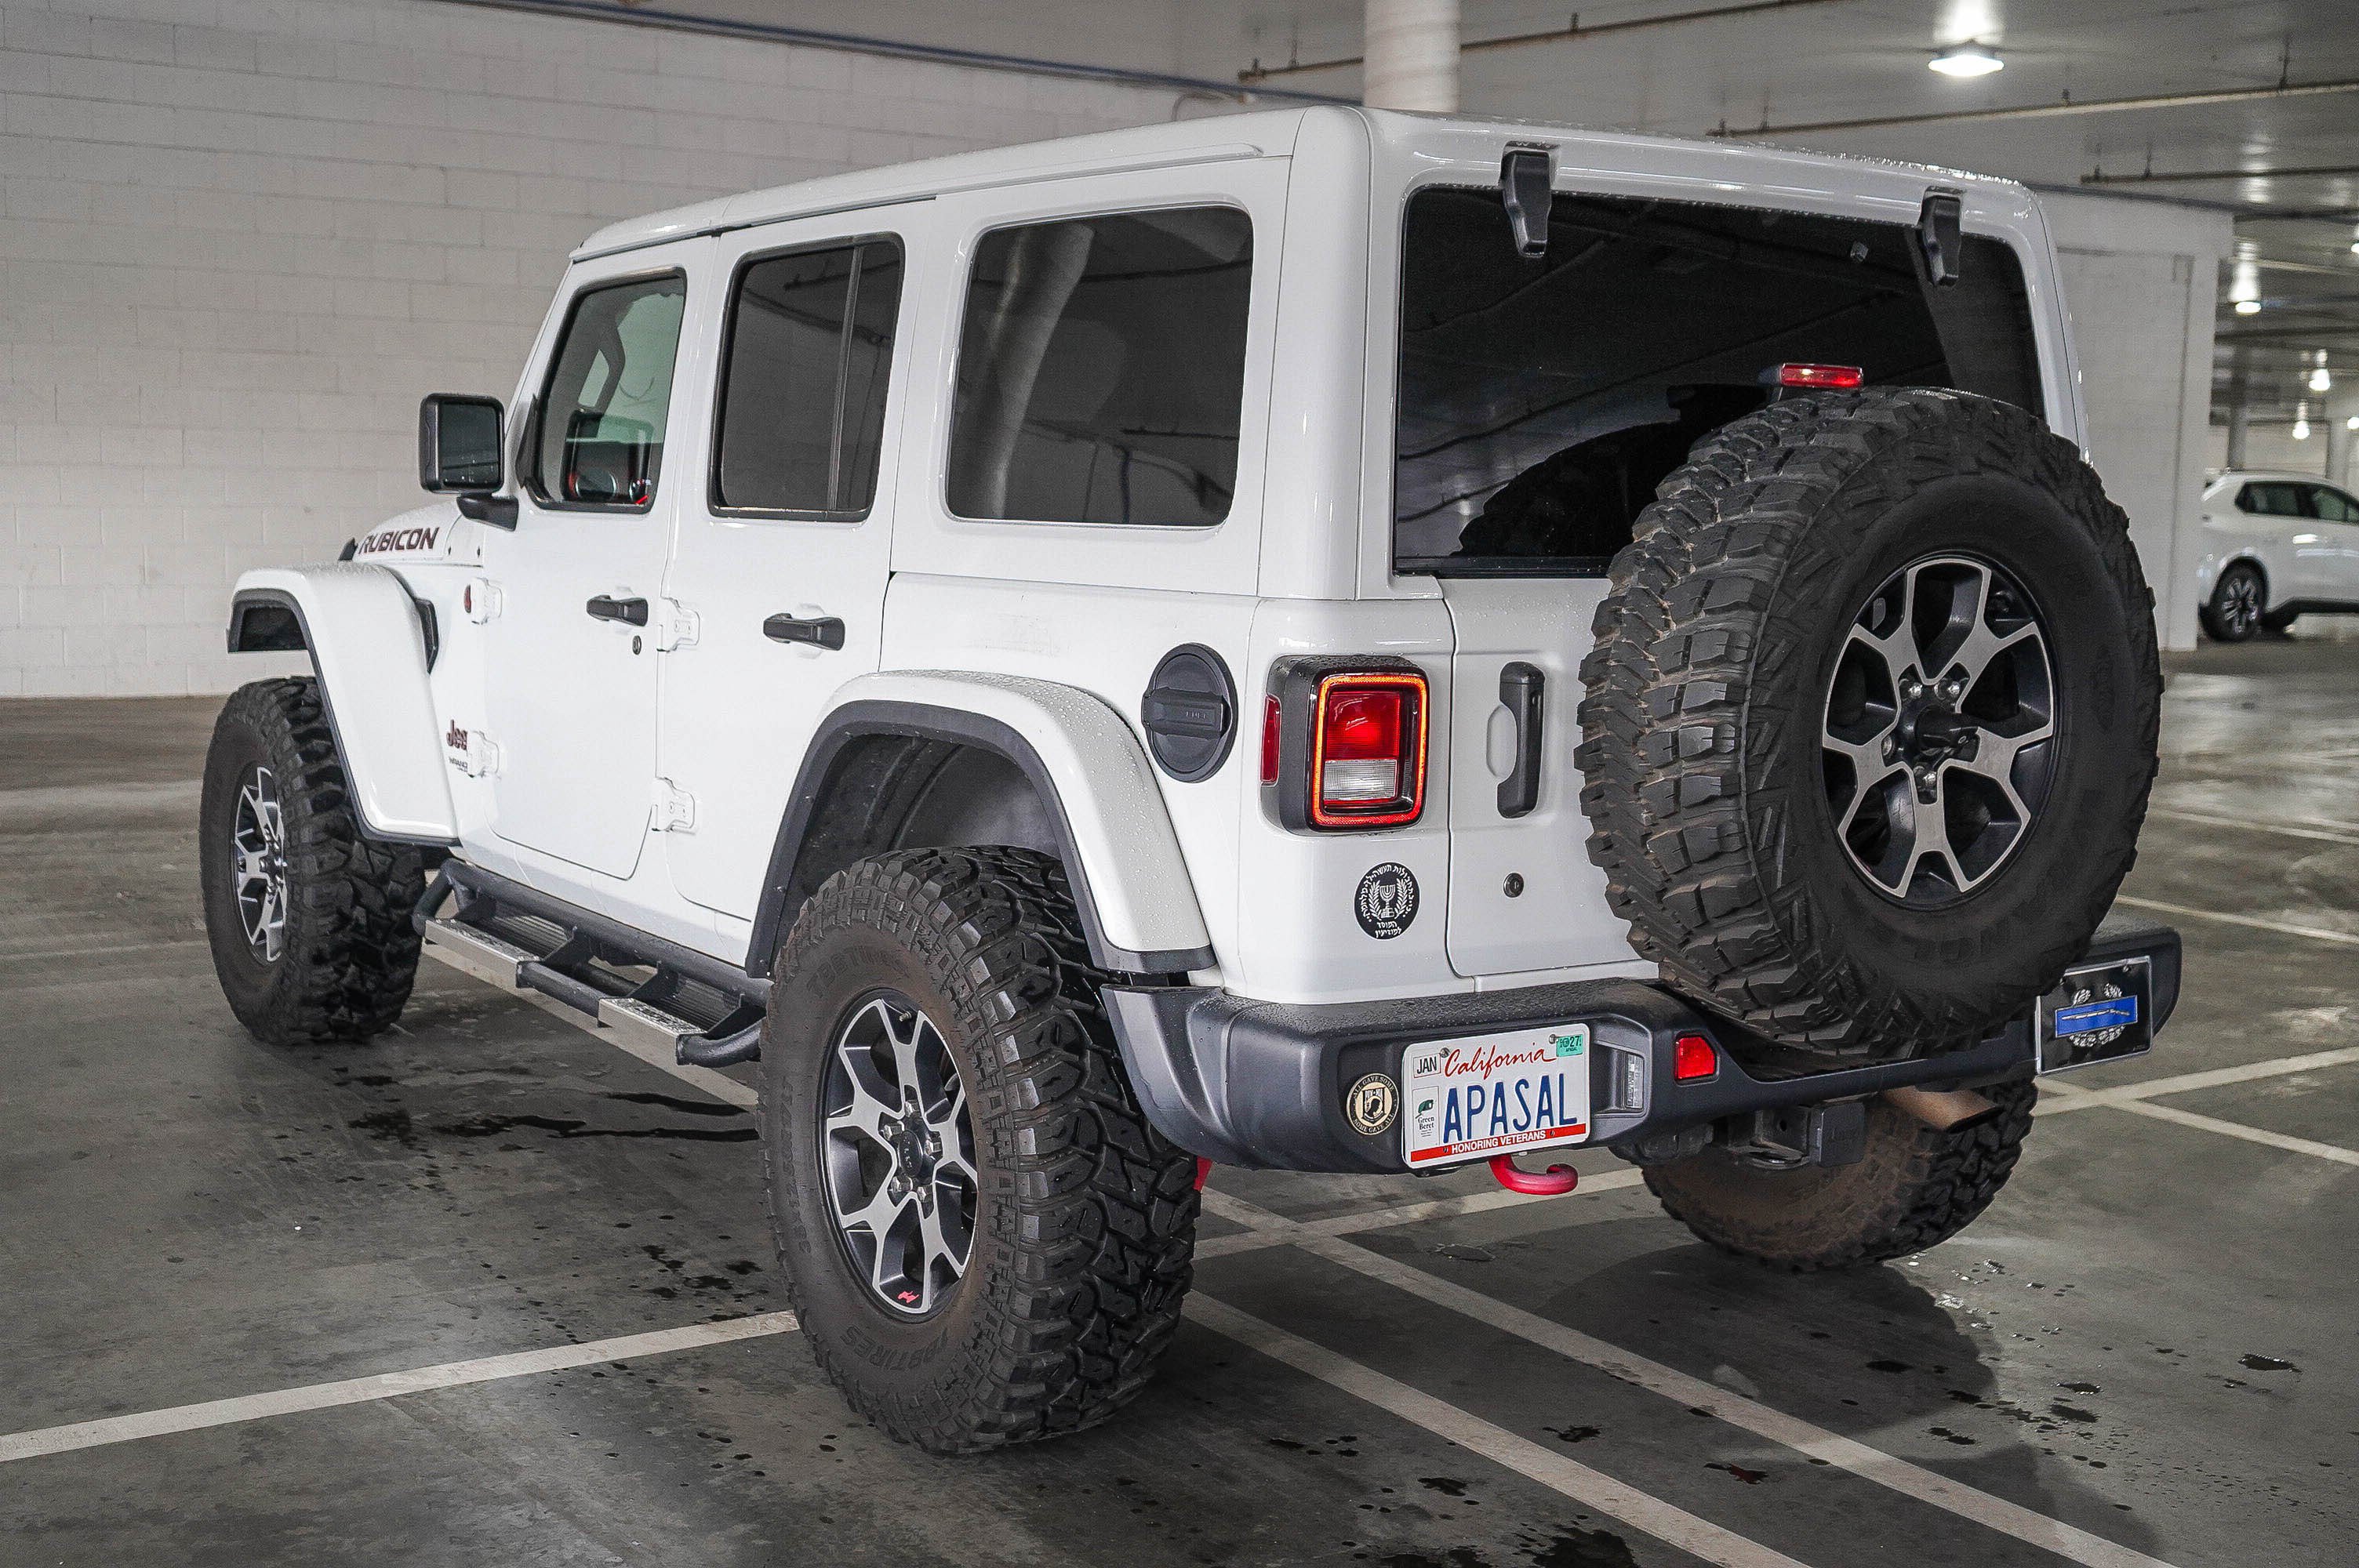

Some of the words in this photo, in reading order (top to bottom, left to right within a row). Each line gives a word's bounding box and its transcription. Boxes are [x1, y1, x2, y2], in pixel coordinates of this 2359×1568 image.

[358, 527, 440, 554] RUBICON
[446, 719, 468, 754] Jee
[1570, 1036, 1580, 1047] 27
[1417, 1056, 1438, 1074] JAN
[1445, 1041, 1557, 1080] California
[1362, 1076, 1379, 1086] GAVE
[1379, 1076, 1394, 1091] SOME
[1443, 1073, 1577, 1142] APASAL
[1354, 1119, 1367, 1131] SOME
[1452, 1137, 1499, 1154] HONORING
[1500, 1131, 1546, 1145] VETERANS
